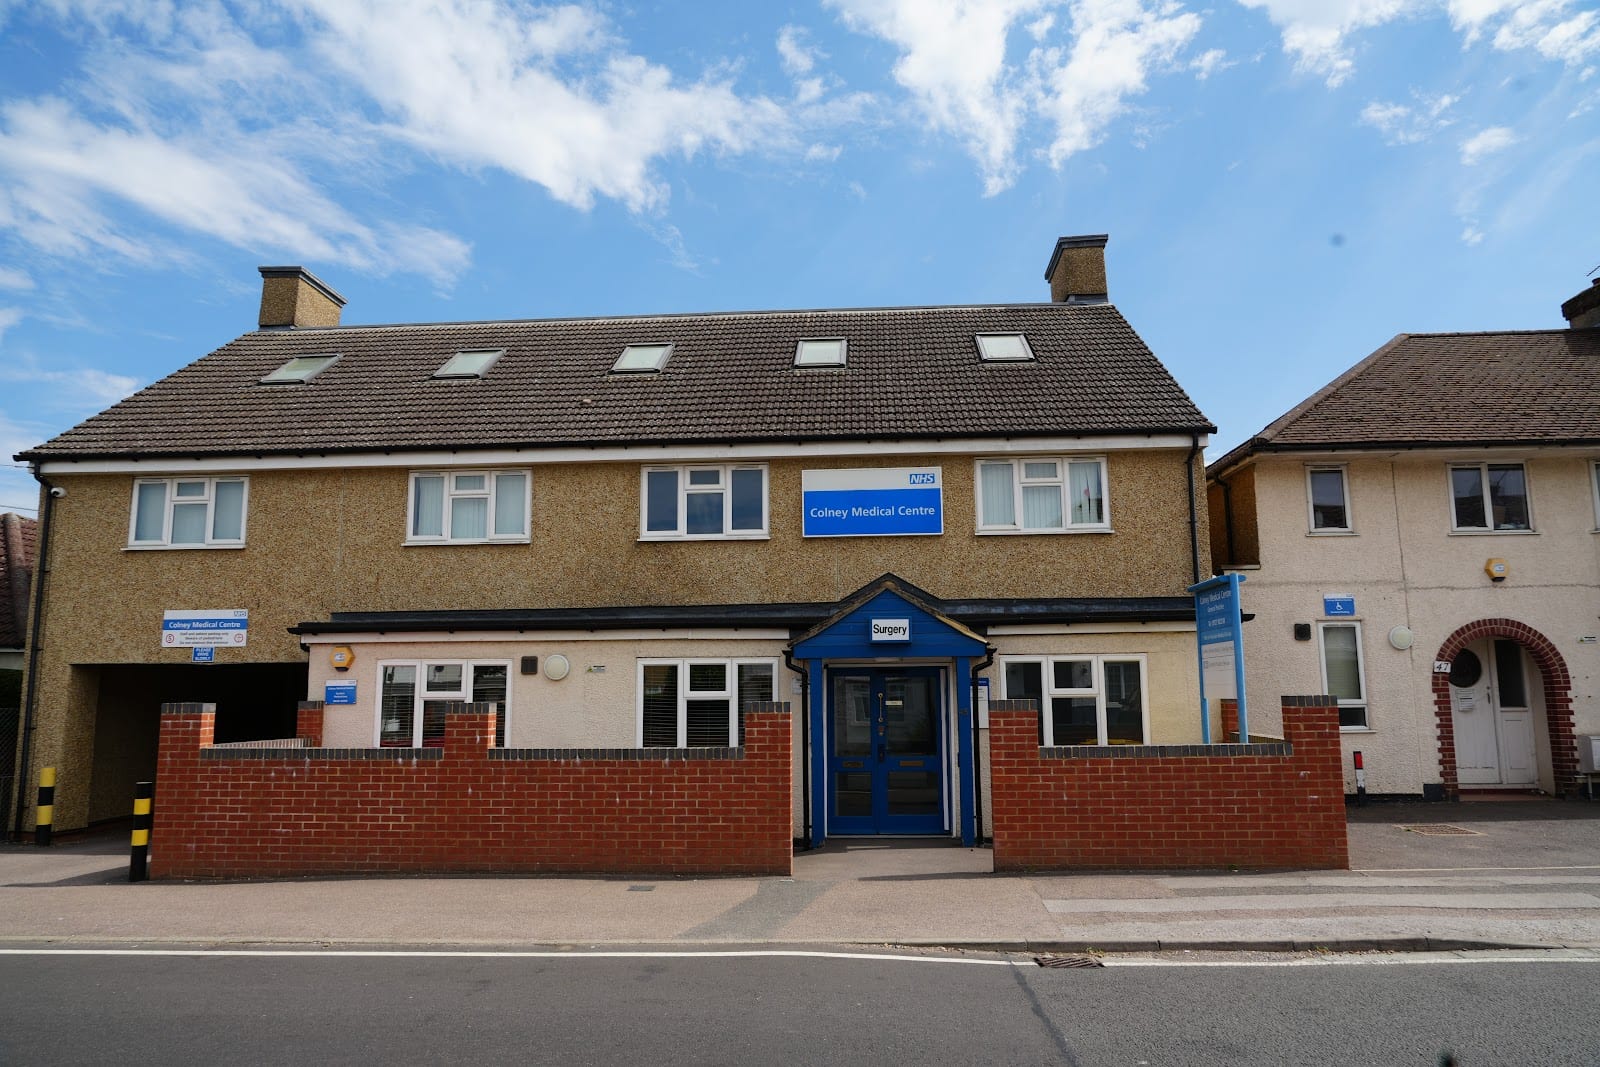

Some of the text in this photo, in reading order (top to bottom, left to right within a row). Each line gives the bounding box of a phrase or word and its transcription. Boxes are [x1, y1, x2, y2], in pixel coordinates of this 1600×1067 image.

[910, 474, 934, 484] NHS
[810, 505, 935, 519] Colney Medical Centre
[169, 621, 191, 629] Colney
[873, 623, 907, 636] Surgery
[1436, 662, 1449, 671] 47
